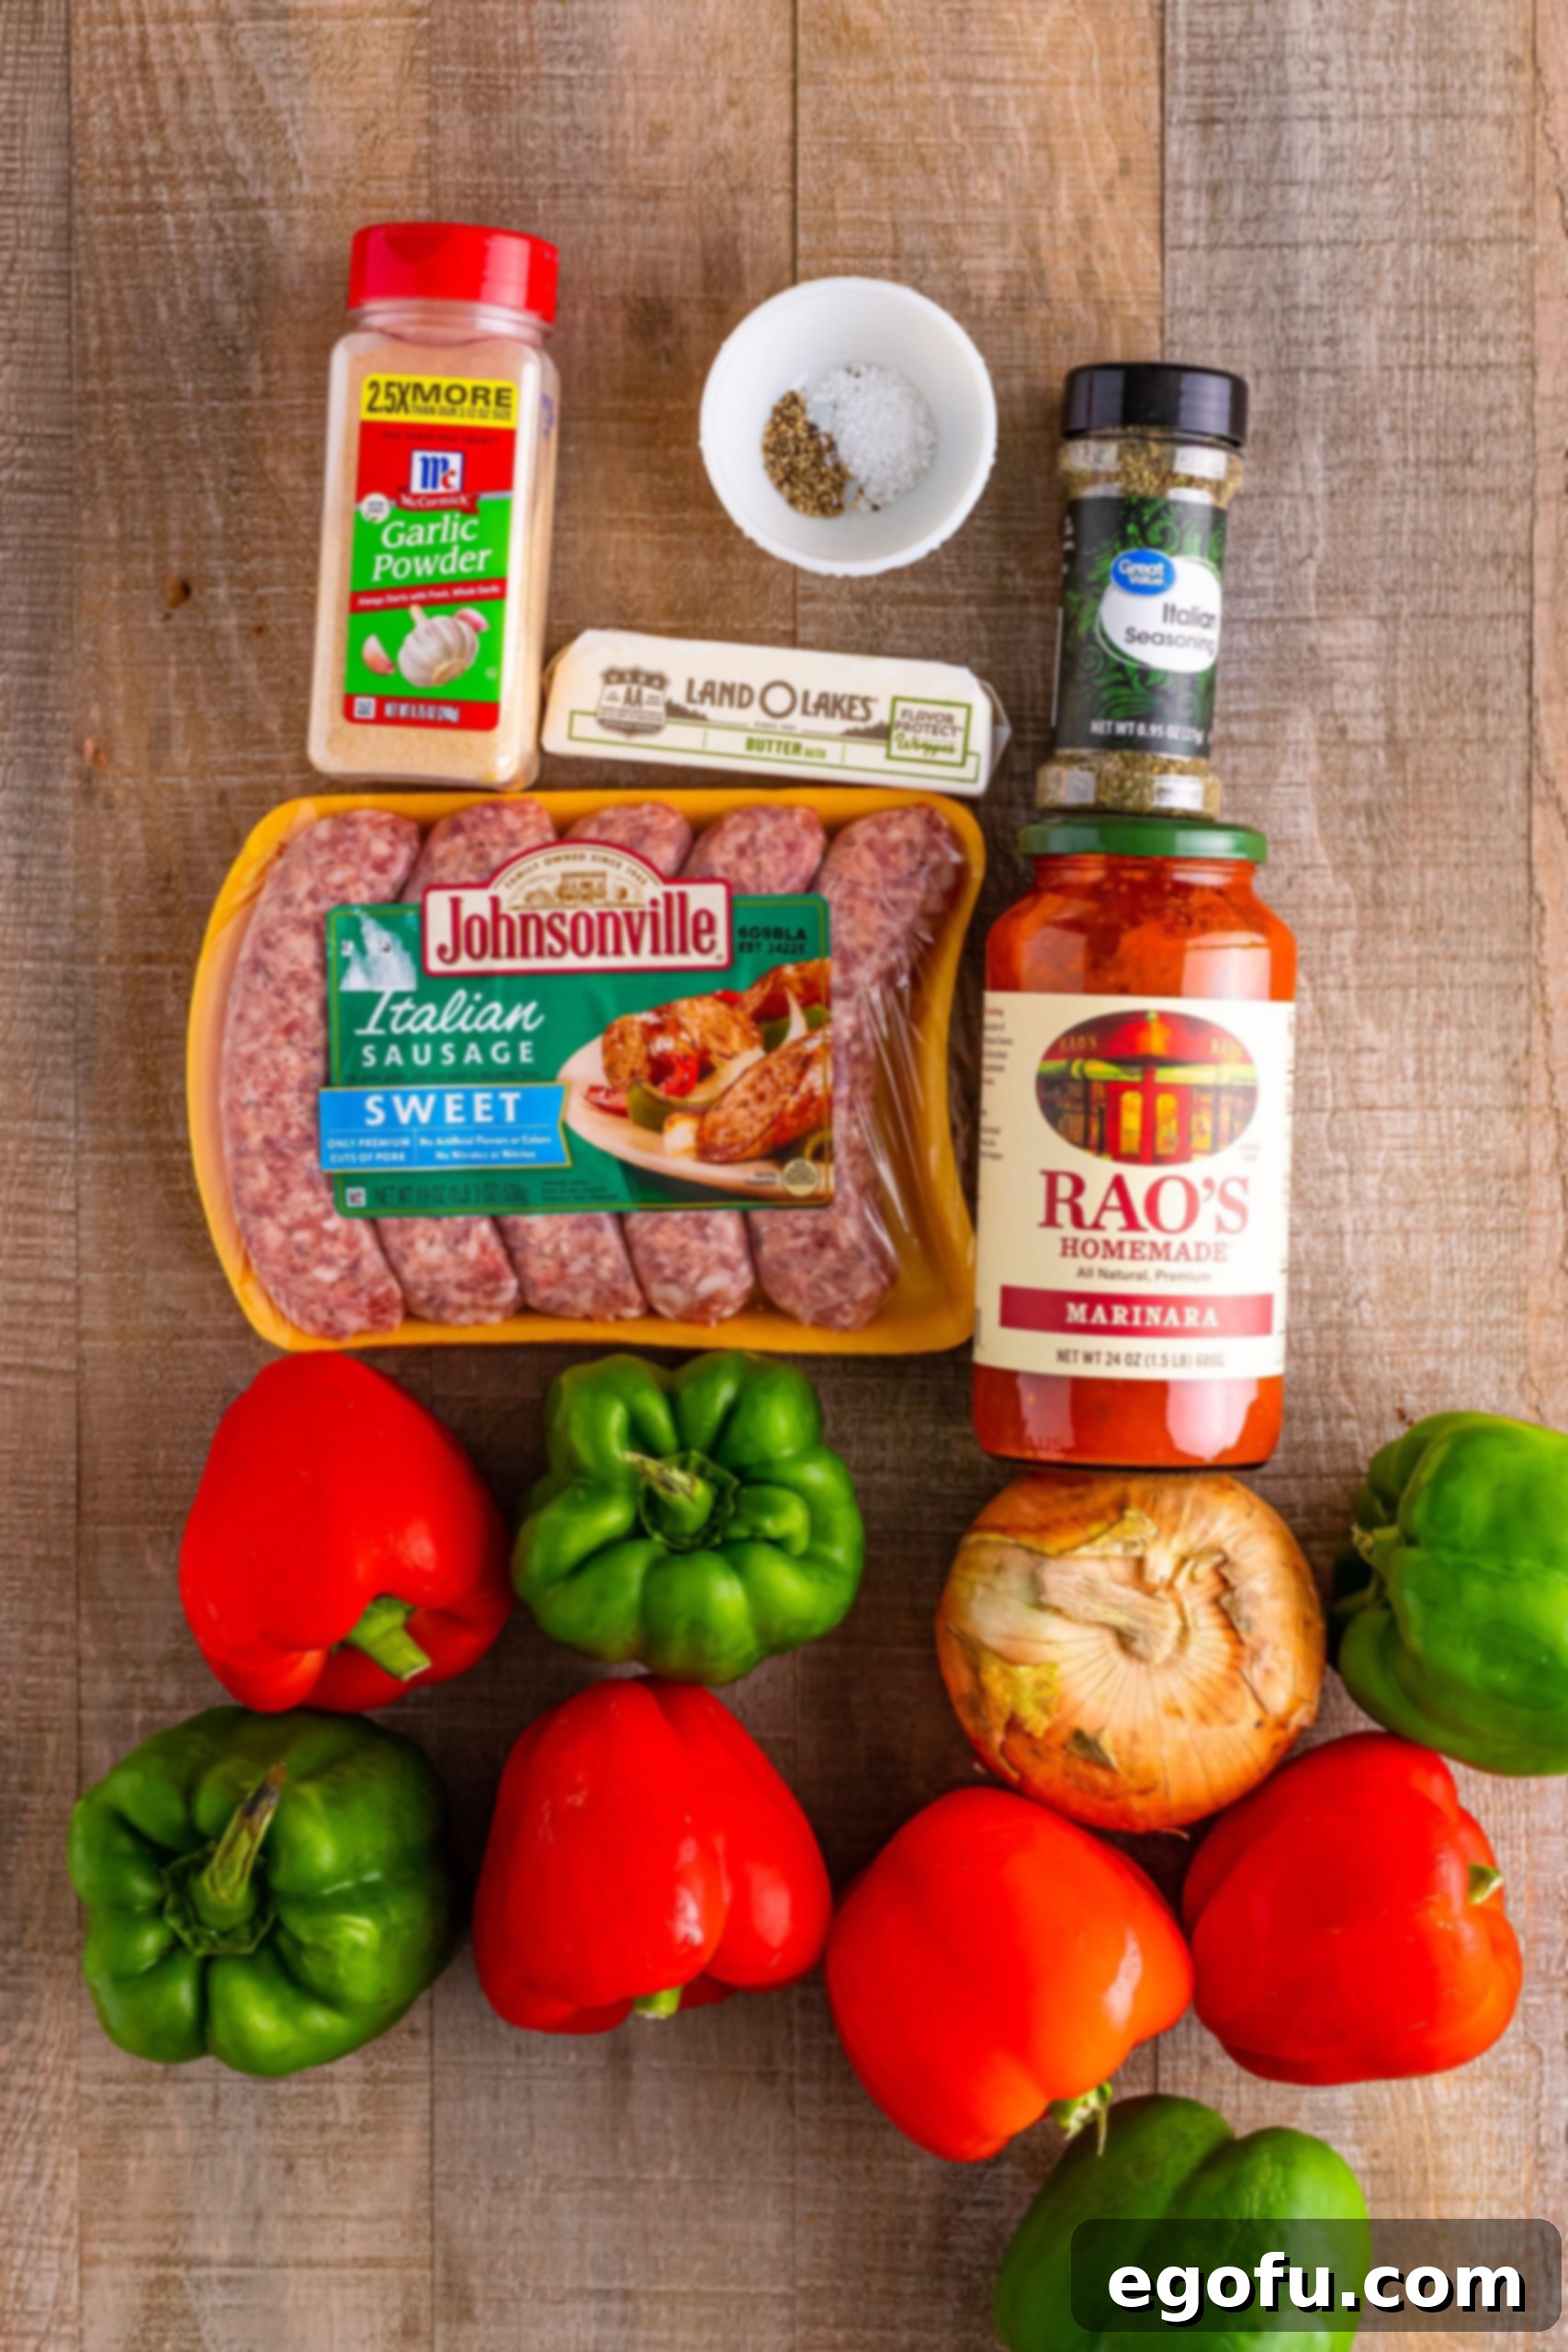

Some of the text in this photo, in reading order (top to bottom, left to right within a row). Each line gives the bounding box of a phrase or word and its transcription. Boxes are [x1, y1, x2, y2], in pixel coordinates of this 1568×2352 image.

[412, 382, 513, 409] MORE
[400, 492, 470, 509] McCormick
[380, 512, 479, 549] Garlic
[371, 544, 491, 582] Powder
[1118, 556, 1166, 579] Great
[1128, 572, 1166, 587] Value
[1124, 626, 1215, 657] Seasoning
[685, 677, 755, 710] LAND
[759, 679, 798, 720] O
[801, 689, 874, 723] LAKES
[894, 719, 957, 738] PROTECT
[901, 707, 954, 725] FLAVOR
[1090, 719, 1113, 735] NET
[1115, 721, 1135, 736] WT
[1137, 722, 1164, 739] 0.95
[745, 736, 803, 757] BUTTER
[435, 890, 719, 965] Johnsonville
[354, 989, 544, 1035] Italian
[361, 1040, 536, 1068] SAUSAGE
[364, 1091, 522, 1127] SWEET
[358, 1136, 411, 1148] PREMIUM
[358, 1151, 374, 1162] OF
[376, 1150, 406, 1162] PORK
[1037, 1169, 1249, 1235] RAO'S
[1059, 1237, 1228, 1263] HOMEMADE
[1077, 1266, 1212, 1282] All Natural, Premium
[1065, 1301, 1219, 1329] MARINARA
[1056, 1349, 1079, 1364] NET
[1082, 1350, 1102, 1365] WT
[1105, 1351, 1122, 1367] 24
[1124, 1352, 1143, 1367] OZ
[1145, 1353, 1168, 1368] (1.5
